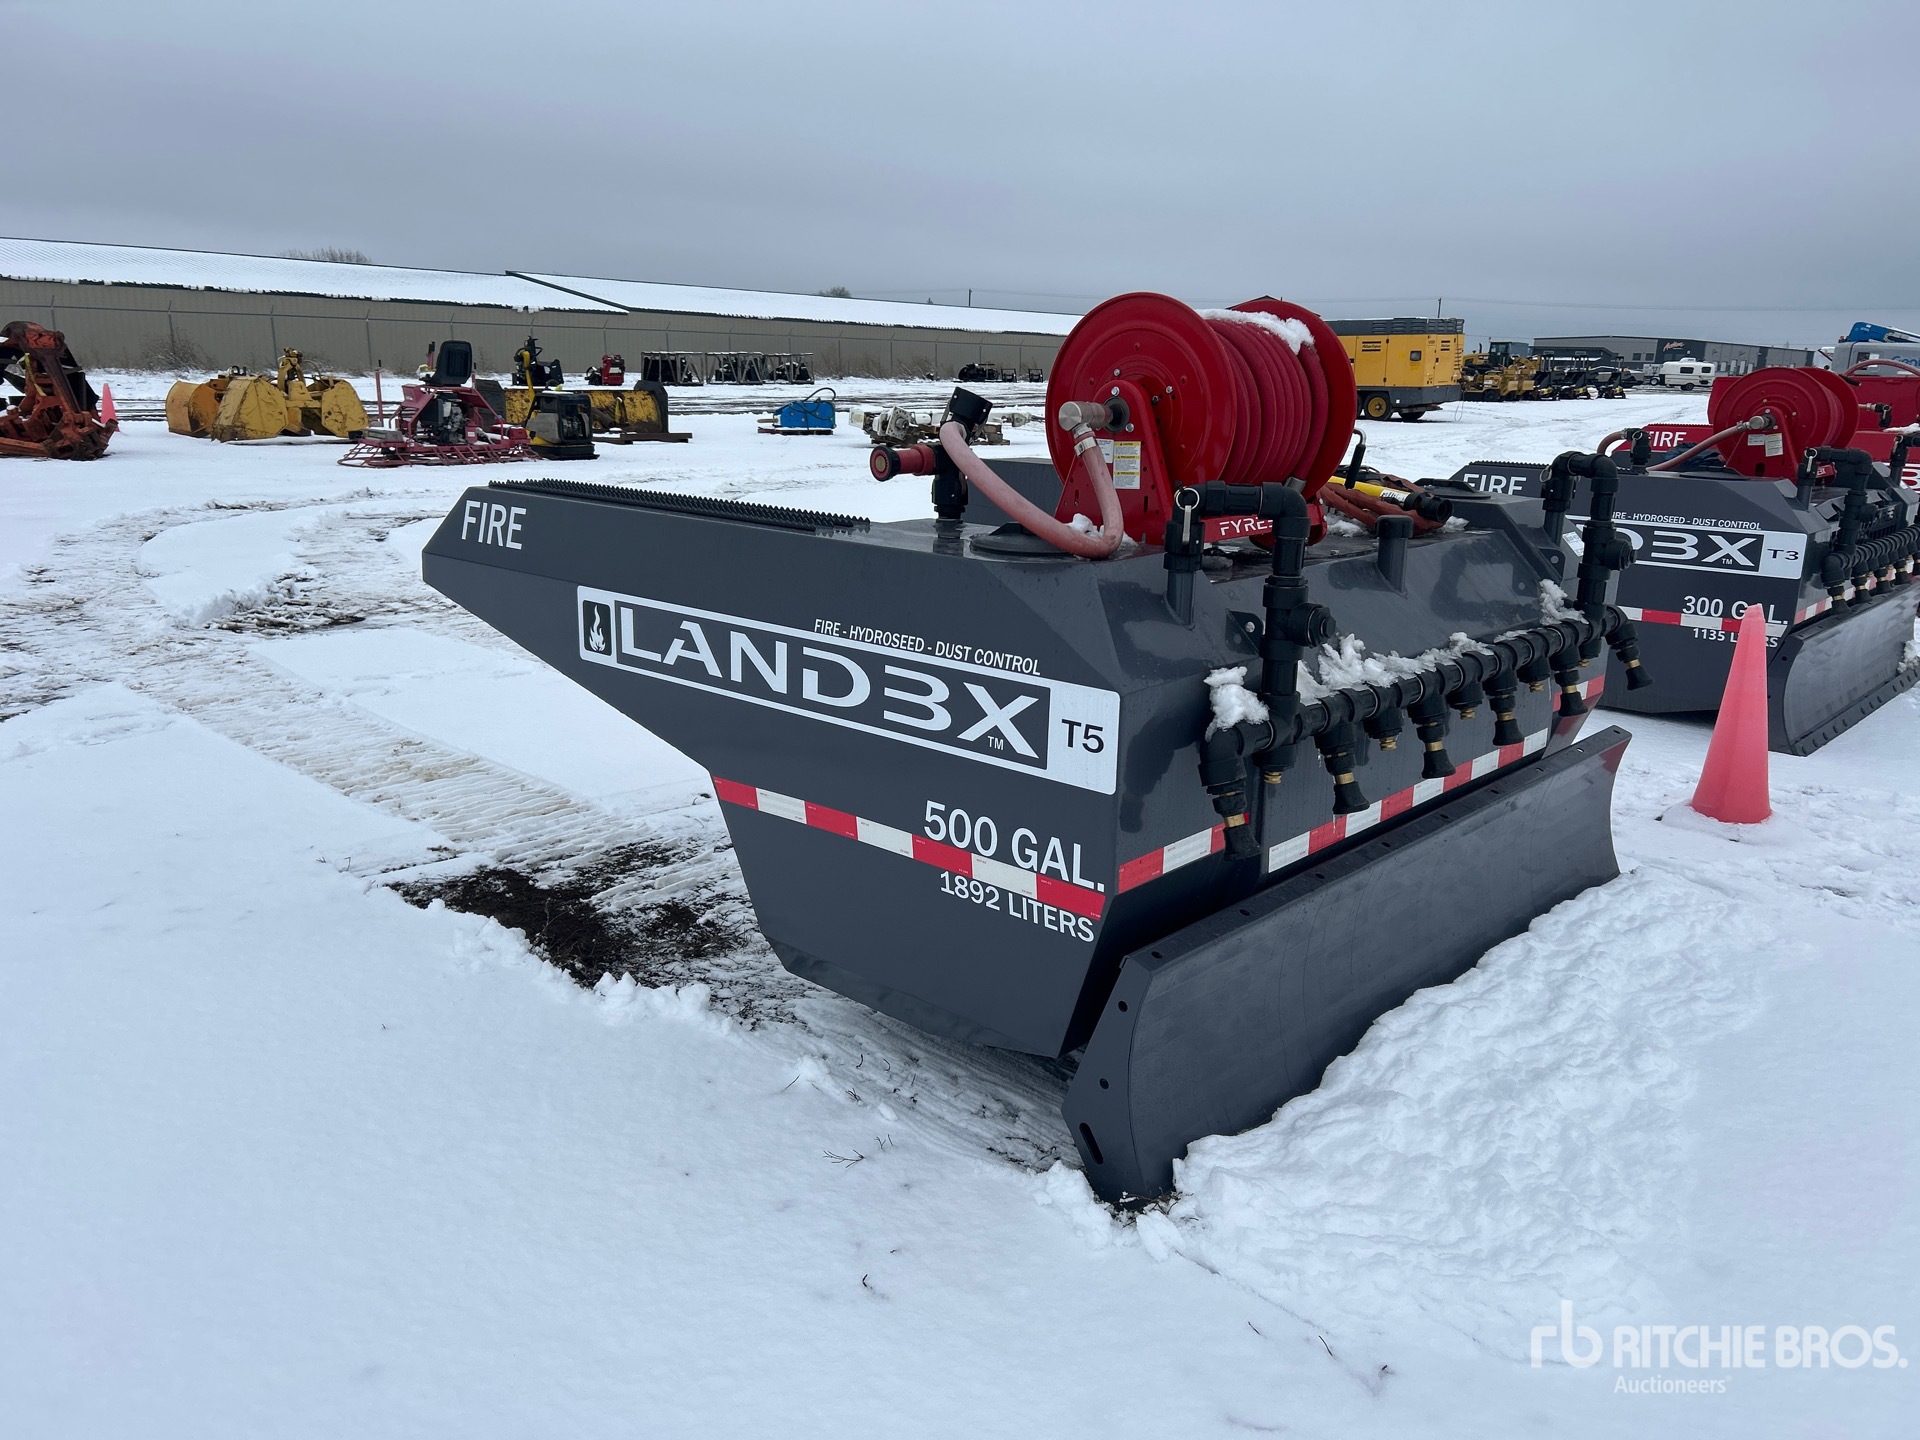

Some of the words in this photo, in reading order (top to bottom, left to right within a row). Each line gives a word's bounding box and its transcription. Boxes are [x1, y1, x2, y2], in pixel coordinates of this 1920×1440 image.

[461, 499, 527, 550] FIRE
[1633, 513, 1686, 525] HYDROSEED
[1692, 517, 1718, 527] DUST
[1718, 520, 1762, 531] CONTROL
[1767, 548, 1799, 561] T3
[1682, 595, 1724, 617] 300
[1731, 600, 1788, 625] GL.
[814, 618, 842, 637] FIRE
[849, 624, 925, 652] HYDROSEED
[935, 640, 972, 662] DUST
[974, 648, 1041, 676] CONTROL
[1693, 627, 1726, 642] 1135
[988, 735, 1004, 751] TM
[1061, 718, 1105, 754] T5
[924, 800, 998, 857] 500
[1011, 827, 1105, 893] GAL.
[940, 870, 1000, 911] 1892
[1008, 892, 1095, 943] LITERS
